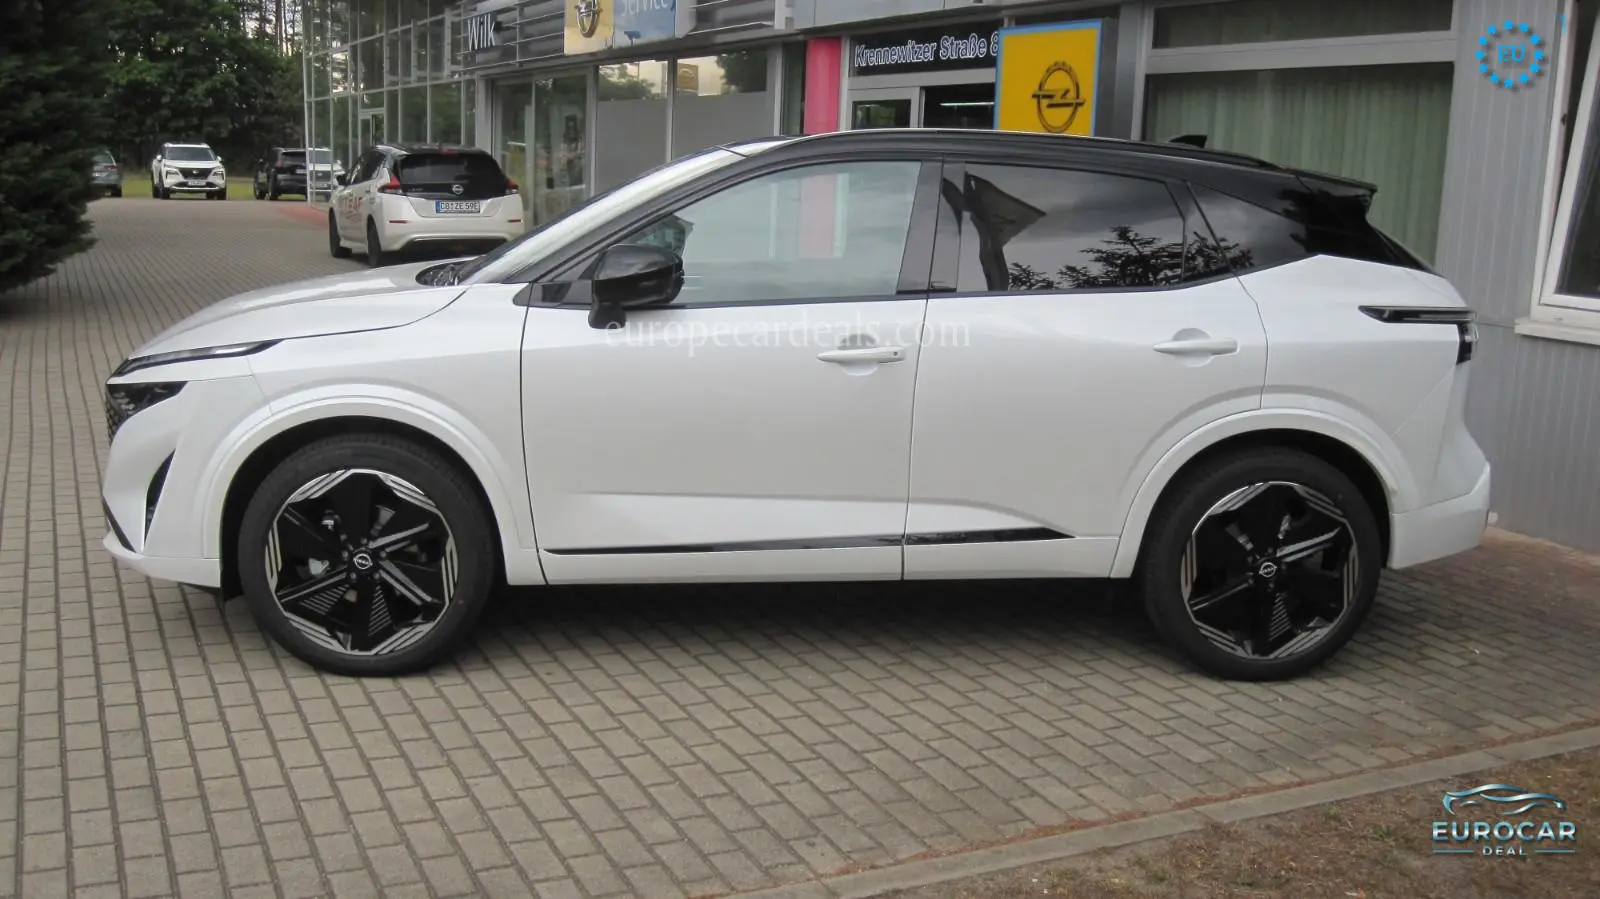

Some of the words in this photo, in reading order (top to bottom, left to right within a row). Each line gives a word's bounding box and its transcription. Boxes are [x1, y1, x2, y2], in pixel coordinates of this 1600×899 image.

[467, 12, 496, 52] Wilk
[855, 39, 937, 67] Krennewitzer
[939, 33, 987, 60] Straße
